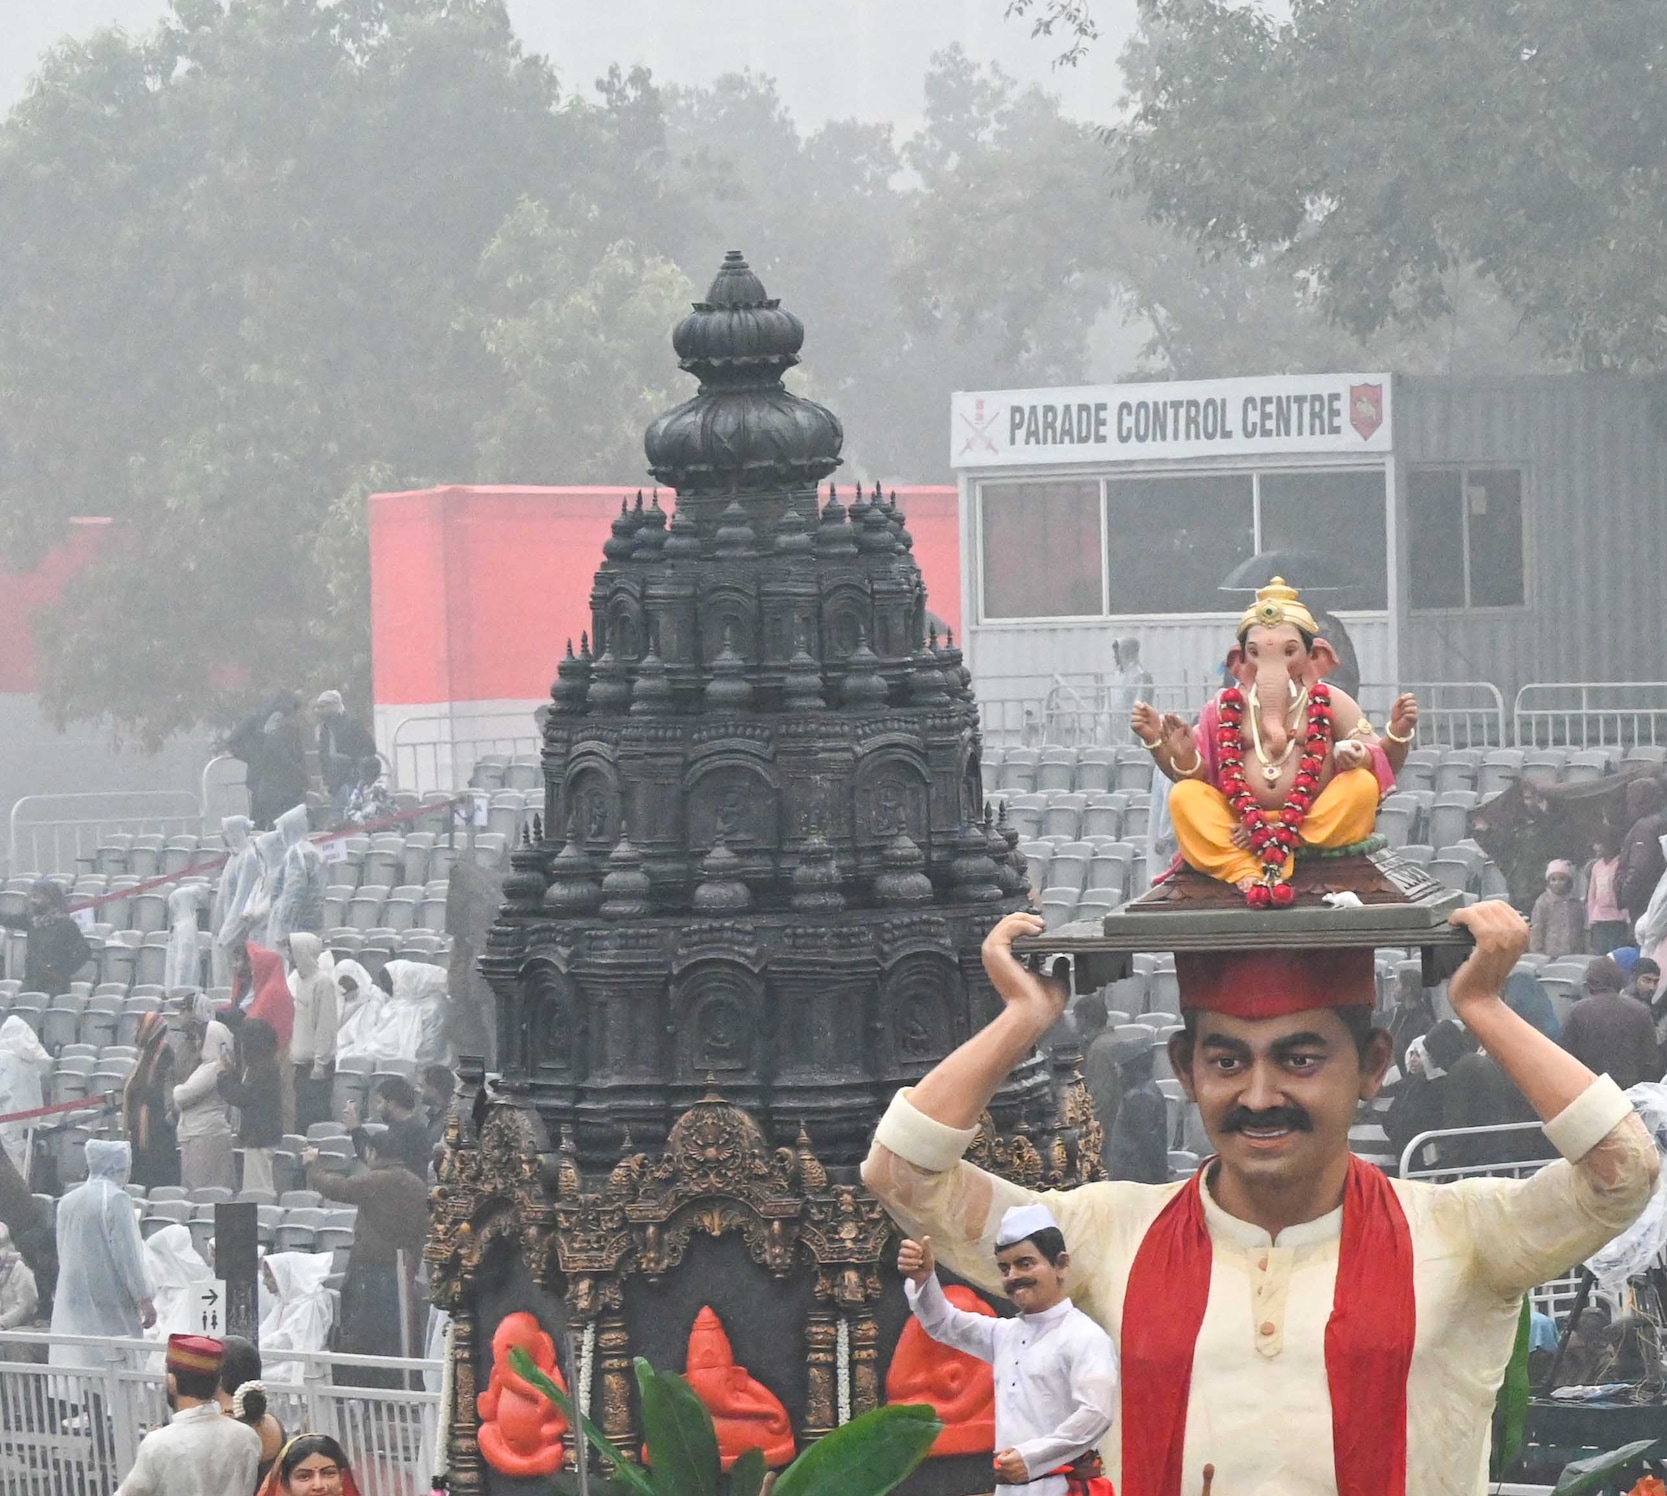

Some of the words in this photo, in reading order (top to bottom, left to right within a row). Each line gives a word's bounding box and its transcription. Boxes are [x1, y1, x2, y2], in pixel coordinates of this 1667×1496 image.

[1009, 402, 1108, 446] PARADE
[1116, 398, 1234, 444] CONTROL
[1241, 392, 1342, 439] CENTRE
